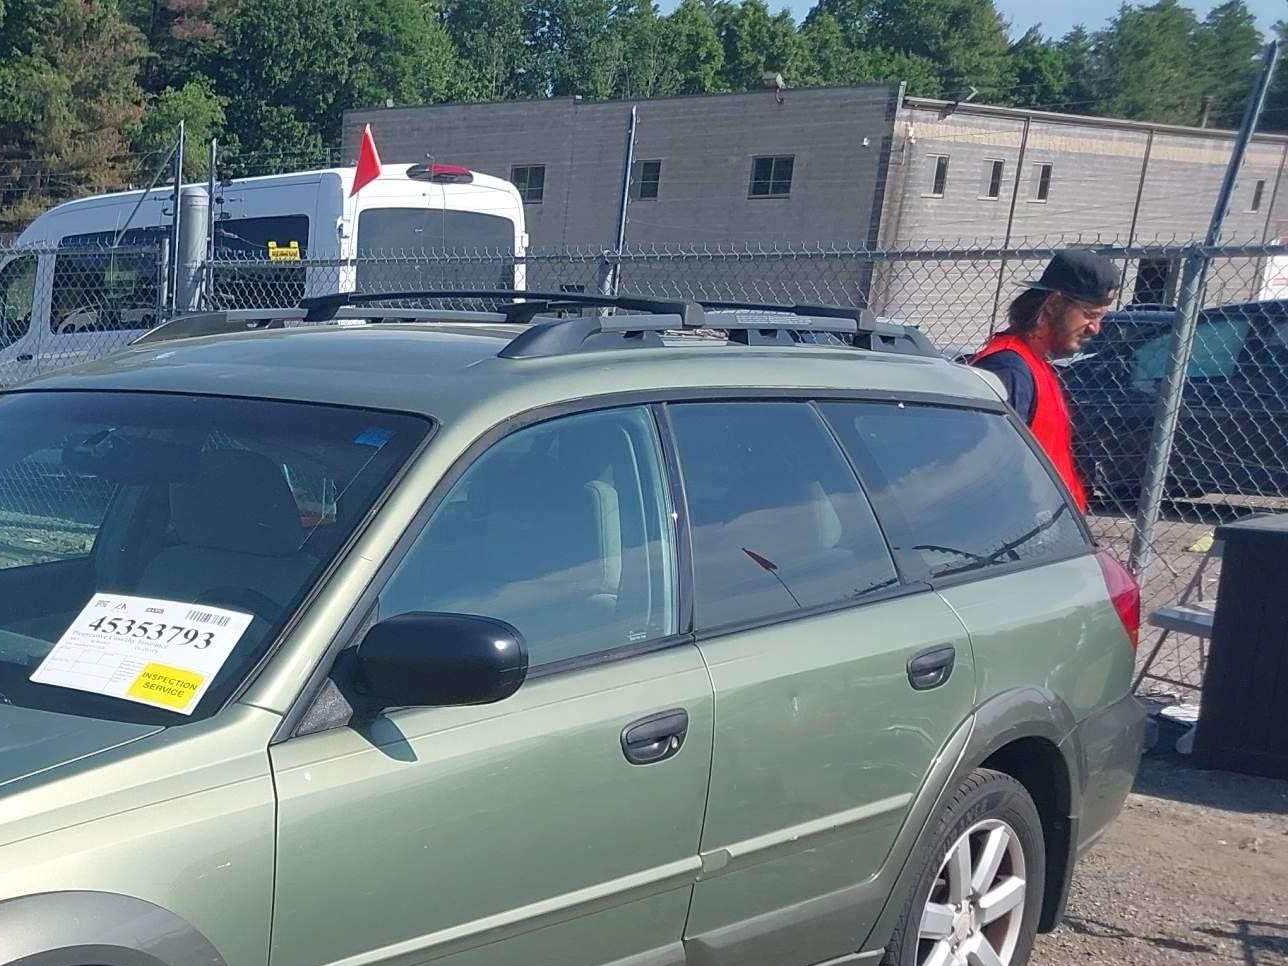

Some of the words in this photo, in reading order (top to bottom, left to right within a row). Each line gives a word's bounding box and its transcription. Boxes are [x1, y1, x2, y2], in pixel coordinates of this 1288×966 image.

[88, 615, 216, 650] 45353793
[142, 671, 198, 691] INSPECTION
[143, 681, 185, 698] SERVICE
